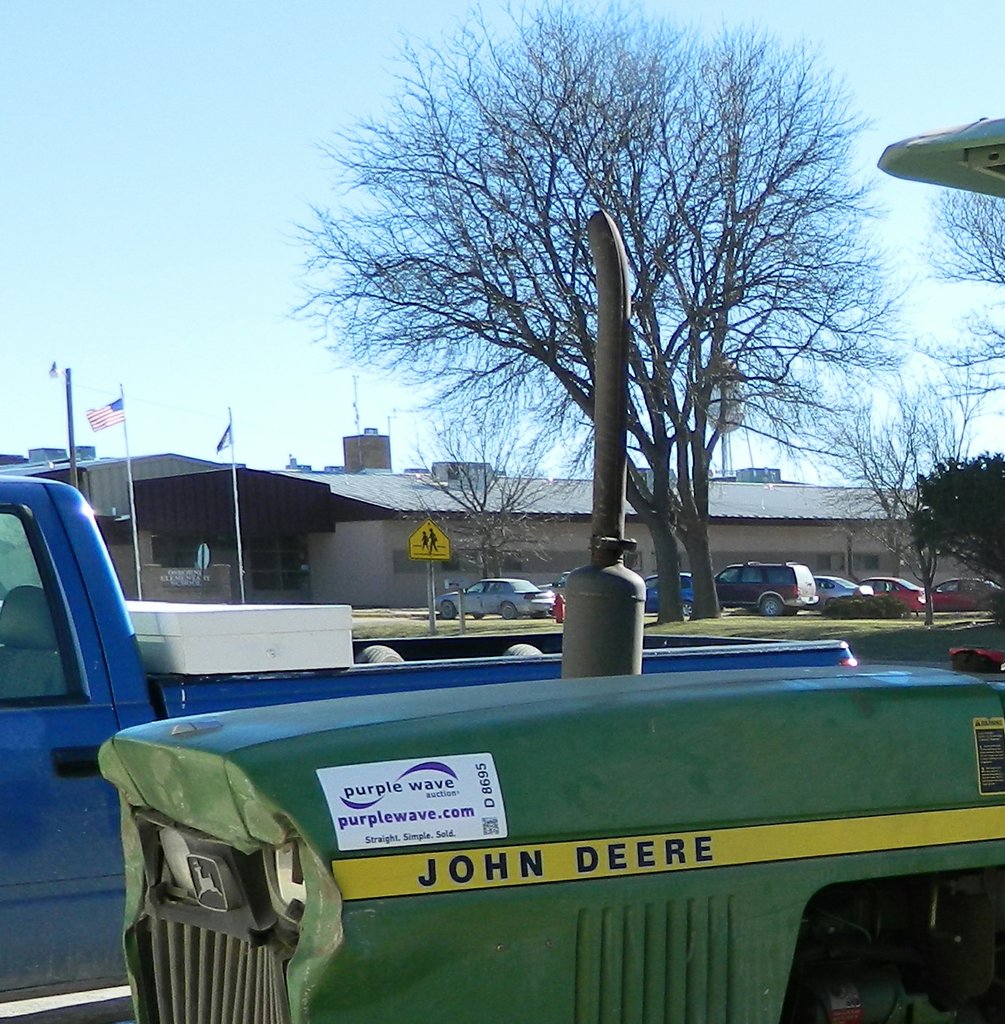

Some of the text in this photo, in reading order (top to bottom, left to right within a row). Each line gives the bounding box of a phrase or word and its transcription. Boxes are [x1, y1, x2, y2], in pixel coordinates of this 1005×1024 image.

[343, 778, 455, 799] purple wave
[475, 762, 495, 808] D 8695
[337, 806, 475, 830] purplewave.com
[365, 829, 456, 845] Straight. Simple. Sold.
[417, 836, 713, 887] JOHN DEERE
